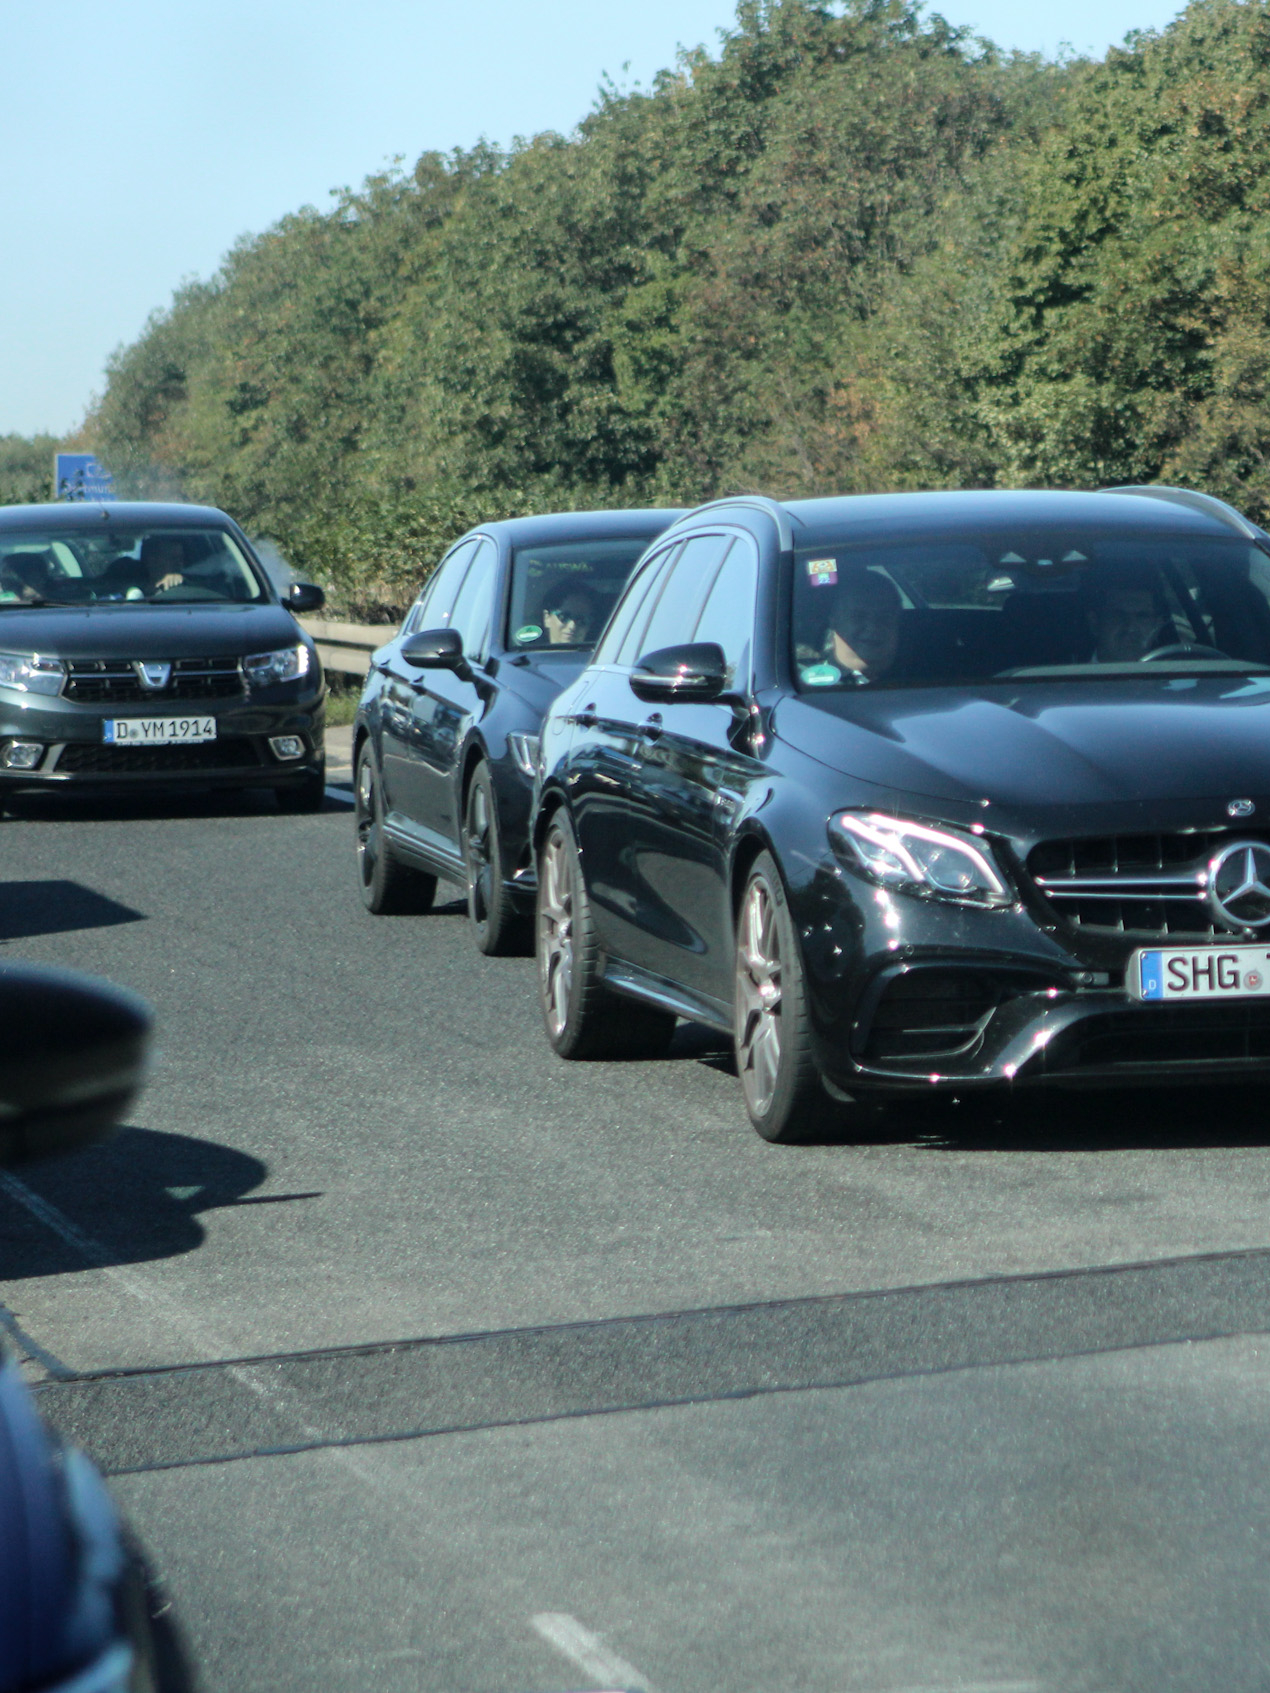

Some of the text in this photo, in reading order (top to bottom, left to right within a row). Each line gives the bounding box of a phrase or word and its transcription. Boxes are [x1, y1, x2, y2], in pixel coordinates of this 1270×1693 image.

[116, 722, 128, 739] D
[1167, 954, 1241, 992] SHG
[1148, 979, 1157, 991] D
